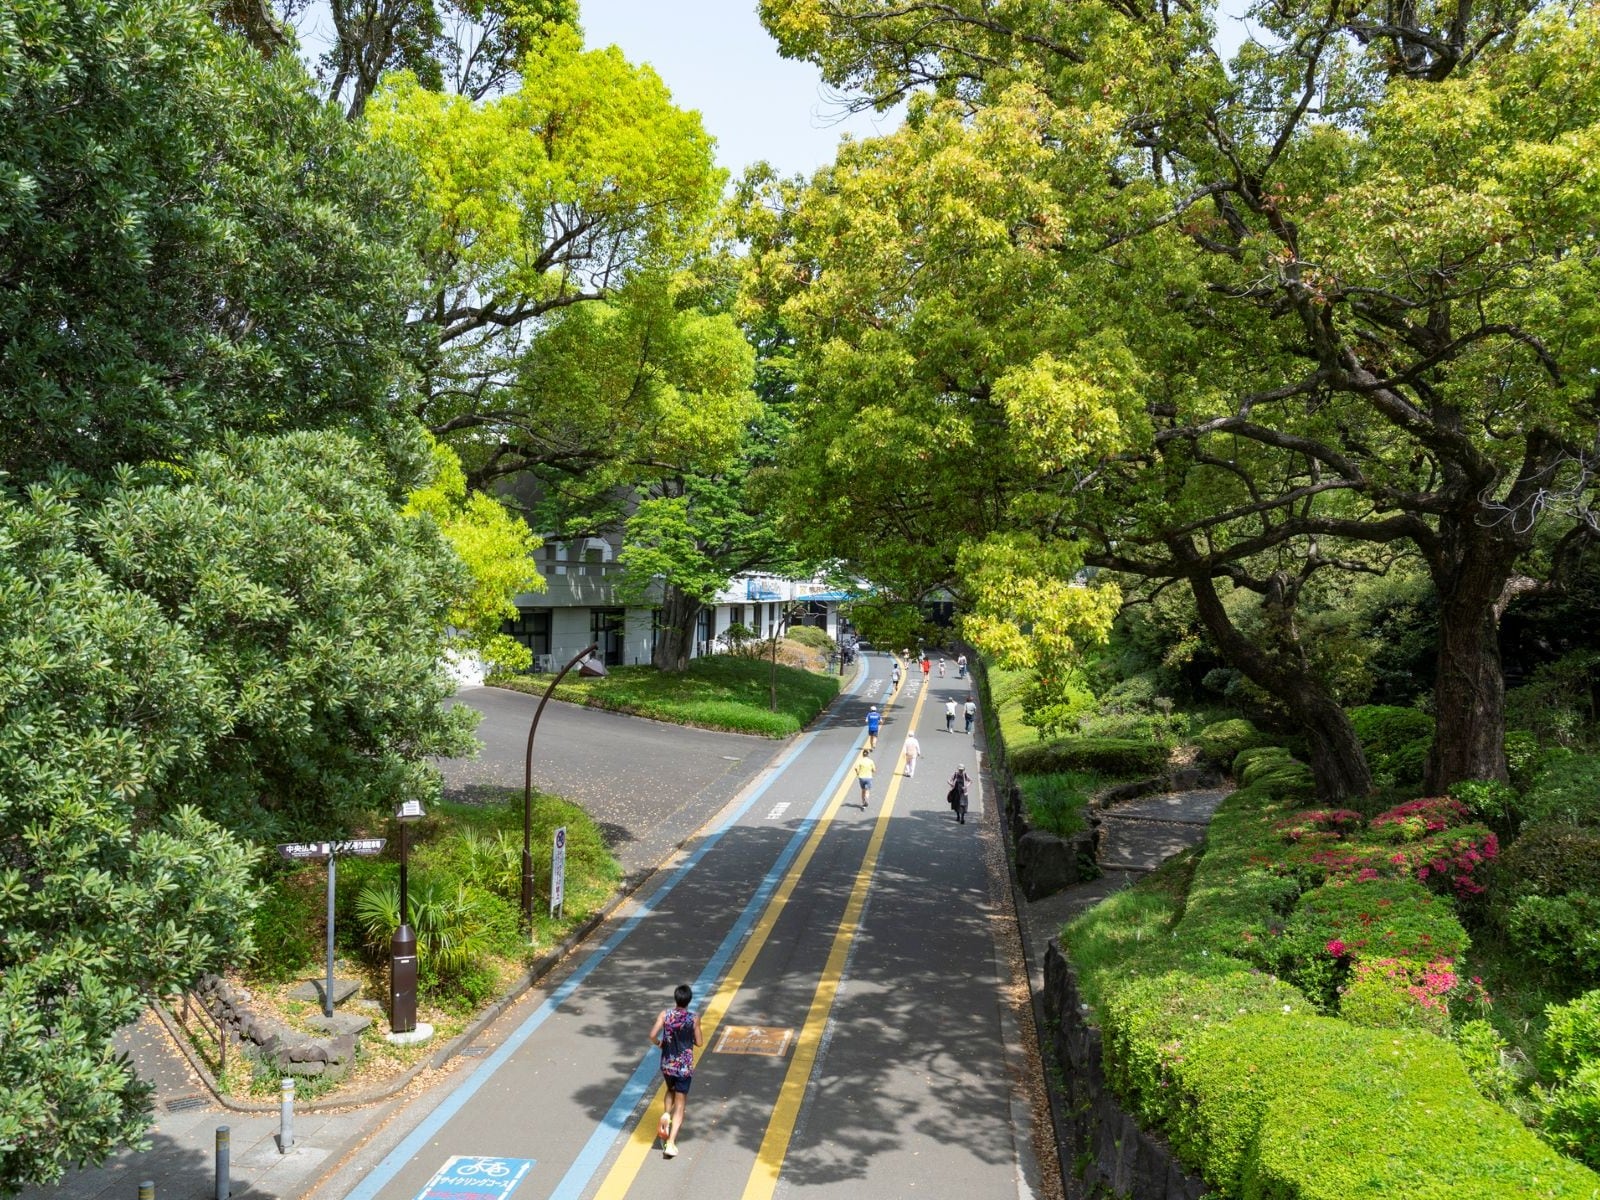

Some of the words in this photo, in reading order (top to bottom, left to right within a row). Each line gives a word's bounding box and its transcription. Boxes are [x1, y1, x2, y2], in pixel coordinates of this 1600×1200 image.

[440, 1176, 509, 1188] サイクリングコース
